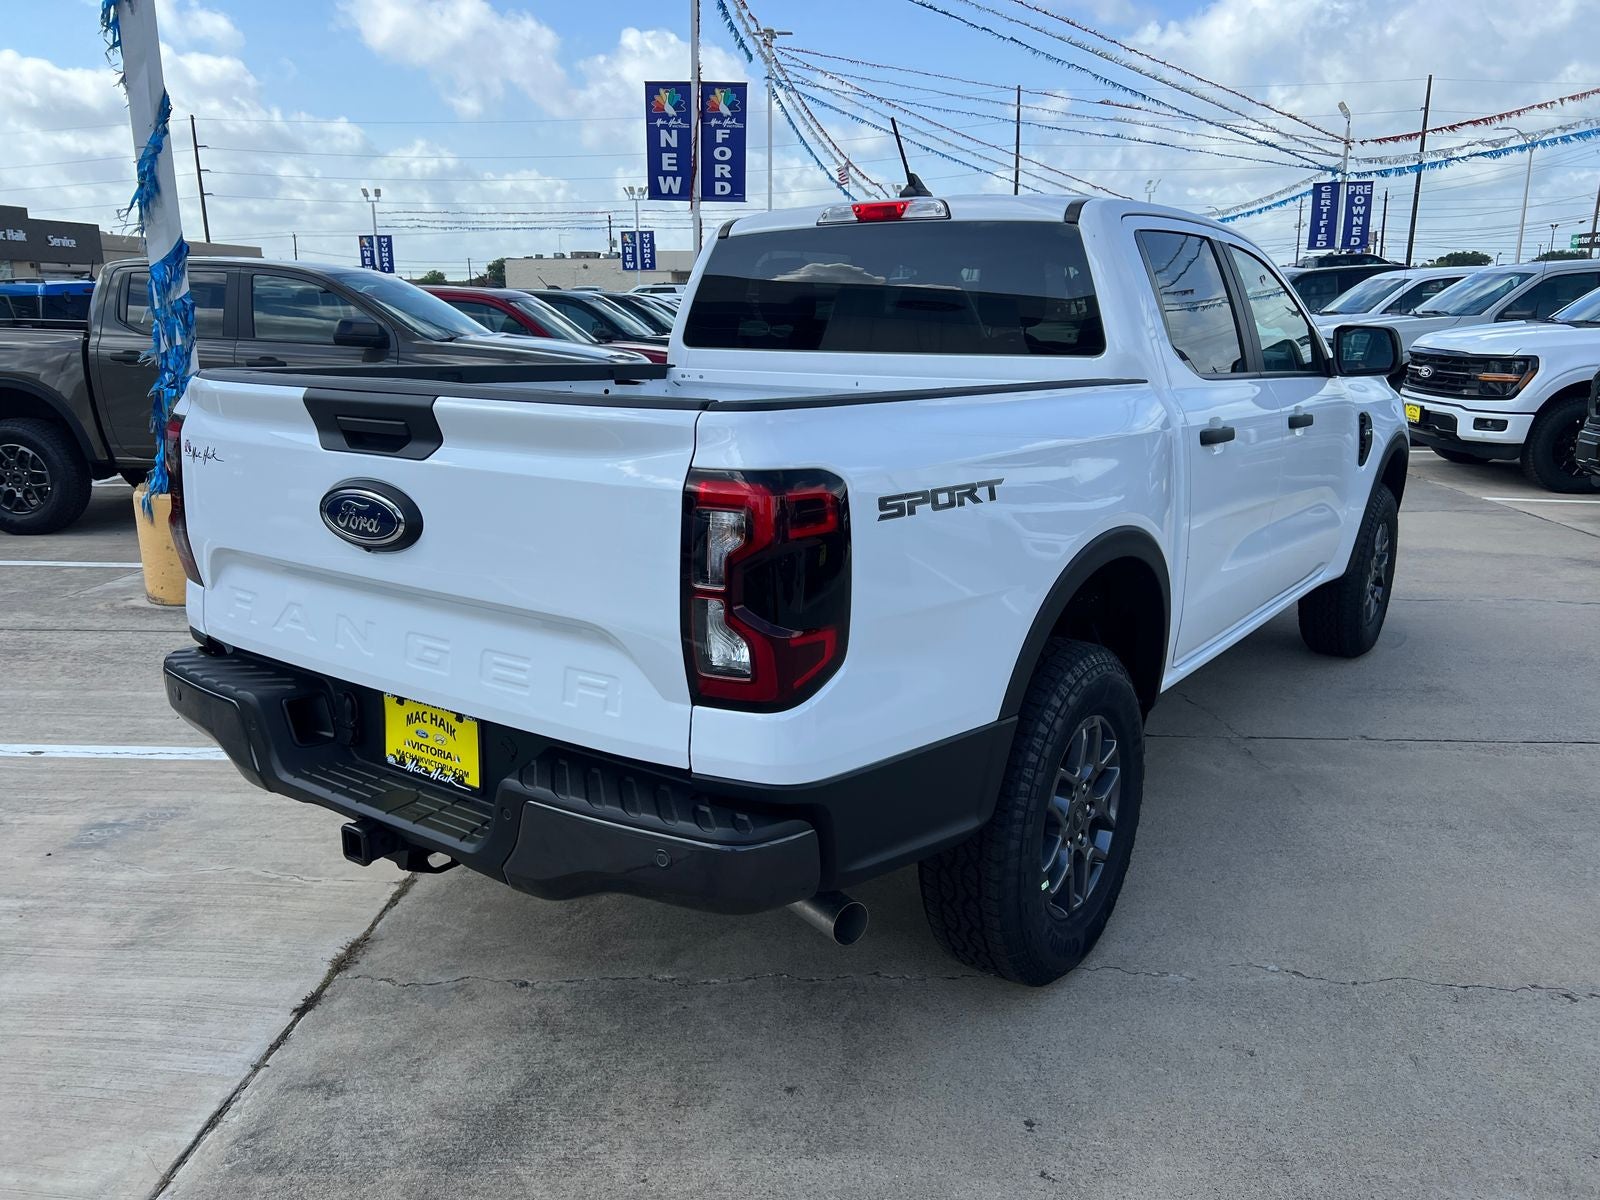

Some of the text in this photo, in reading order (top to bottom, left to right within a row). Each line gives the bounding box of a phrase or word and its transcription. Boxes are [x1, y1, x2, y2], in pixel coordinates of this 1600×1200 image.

[658, 129, 682, 195] NEW
[713, 129, 732, 196] FORD
[1348, 185, 1372, 195] PRE
[1315, 185, 1332, 248] CERTIFIED
[1350, 196, 1366, 246] OWNED
[48, 235, 77, 248] Service
[380, 237, 390, 272] HYUNDAI
[625, 246, 635, 269] NEW
[642, 233, 651, 269] HYUNDAI
[337, 500, 381, 533] Ford
[877, 478, 1005, 522] SPORT
[226, 586, 623, 718] RANGER
[406, 711, 427, 727] MAC
[429, 712, 457, 741] HAIK
[403, 758, 431, 777] Mac
[410, 740, 453, 762] VICTORIA
